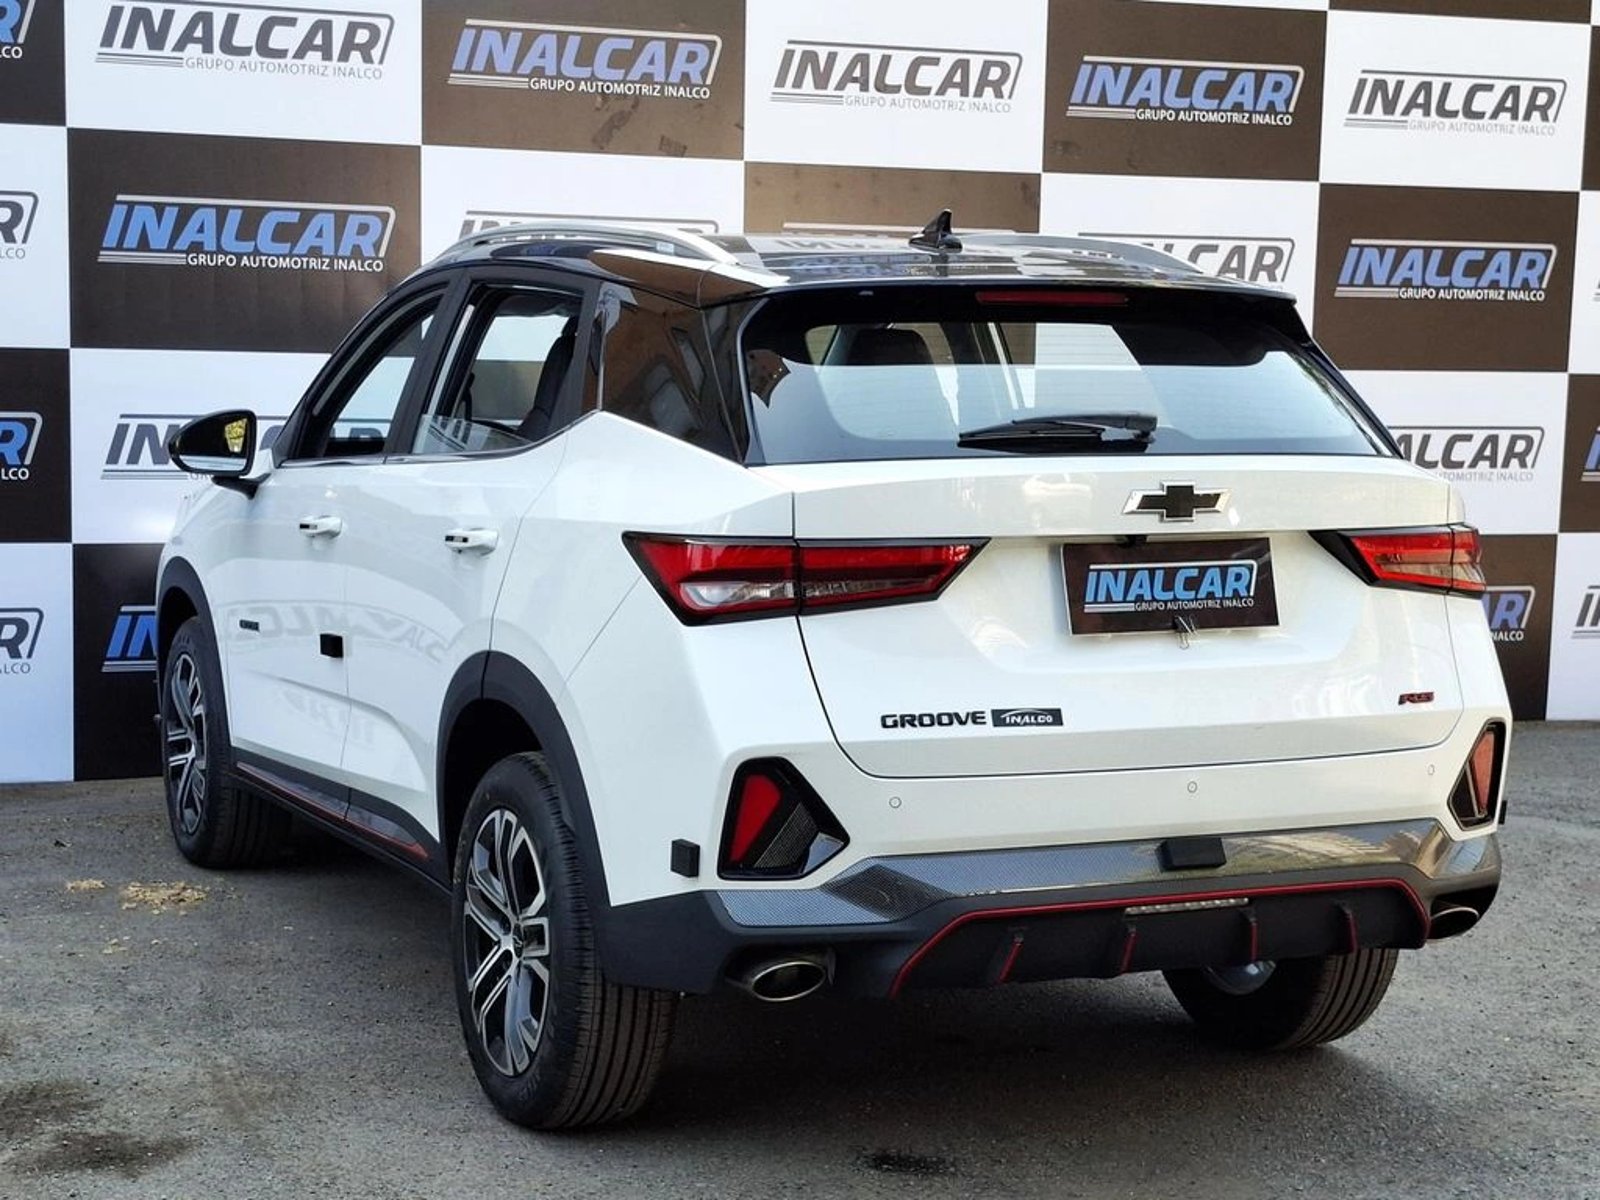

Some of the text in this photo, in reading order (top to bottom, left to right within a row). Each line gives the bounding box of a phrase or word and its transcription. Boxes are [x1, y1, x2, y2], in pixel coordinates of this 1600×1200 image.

[100, 5, 382, 65] INALCAR
[452, 28, 711, 84] INALCAR
[185, 57, 384, 81] GRUPO AUTOMOTRIZ INALCO
[774, 48, 1012, 99] INALCAR
[530, 78, 711, 99] GRUPO AUTOMOTRIZ INALCO
[1069, 64, 1296, 112] INALCAR
[844, 95, 1012, 114] GRUPO AUTOMOTRIZ INALCO
[1348, 78, 1556, 122] INALCAR
[1136, 108, 1293, 126] GRUPO AUTOMOTRIZ INALCO
[1408, 119, 1556, 136] GRUPO AUTOMOTRIZ INALCO
[101, 204, 384, 258] INALCAR
[0, 248, 26, 260] LCO
[187, 252, 384, 272] GRUPO AUTOMOTRIZ INALCO
[1338, 247, 1548, 288] INALCAR
[1399, 287, 1546, 301] GRUPO AUTOMOTRIZ INALCO
[1396, 434, 1535, 469] ALCAR
[1, 467, 30, 481] LCO
[1085, 567, 1250, 602] INALCAR
[1135, 598, 1254, 612] GRUPO AUTOMOTRIZ INALCO
[1490, 630, 1525, 641] NALCO
[880, 710, 1053, 729] GROOVE INALCO
